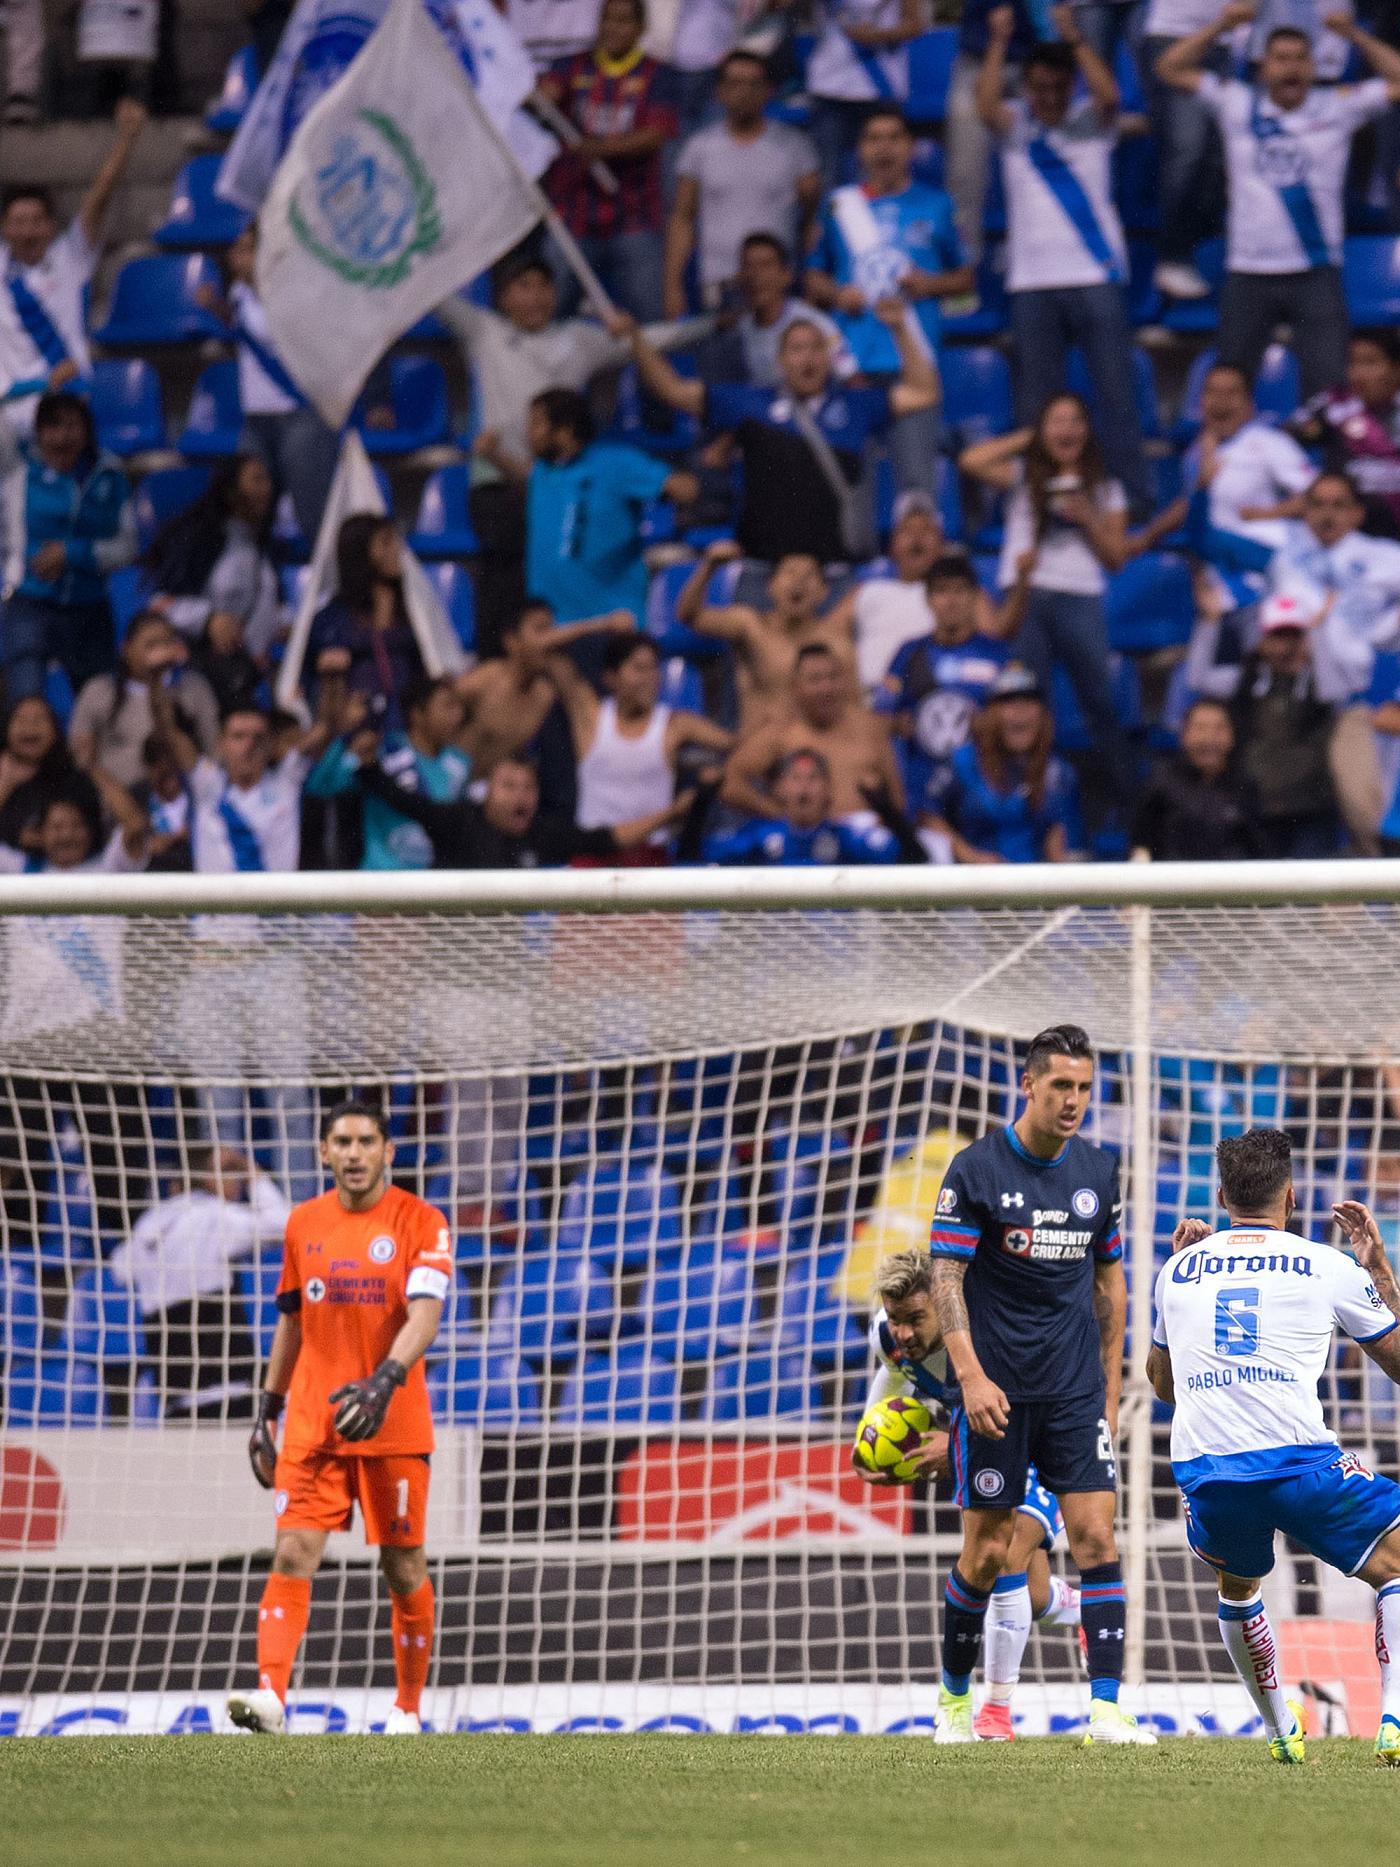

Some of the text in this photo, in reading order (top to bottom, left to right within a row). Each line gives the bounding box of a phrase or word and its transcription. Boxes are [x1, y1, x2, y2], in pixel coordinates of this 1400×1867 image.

[1032, 1229, 1092, 1245] CEMENTO
[1031, 1245, 1087, 1259] CRUZ AZUL
[1172, 1250, 1314, 1284] Corona
[1214, 1287, 1262, 1356] 6
[1188, 1369, 1232, 1391] PABLO
[396, 1478, 409, 1518] 1
